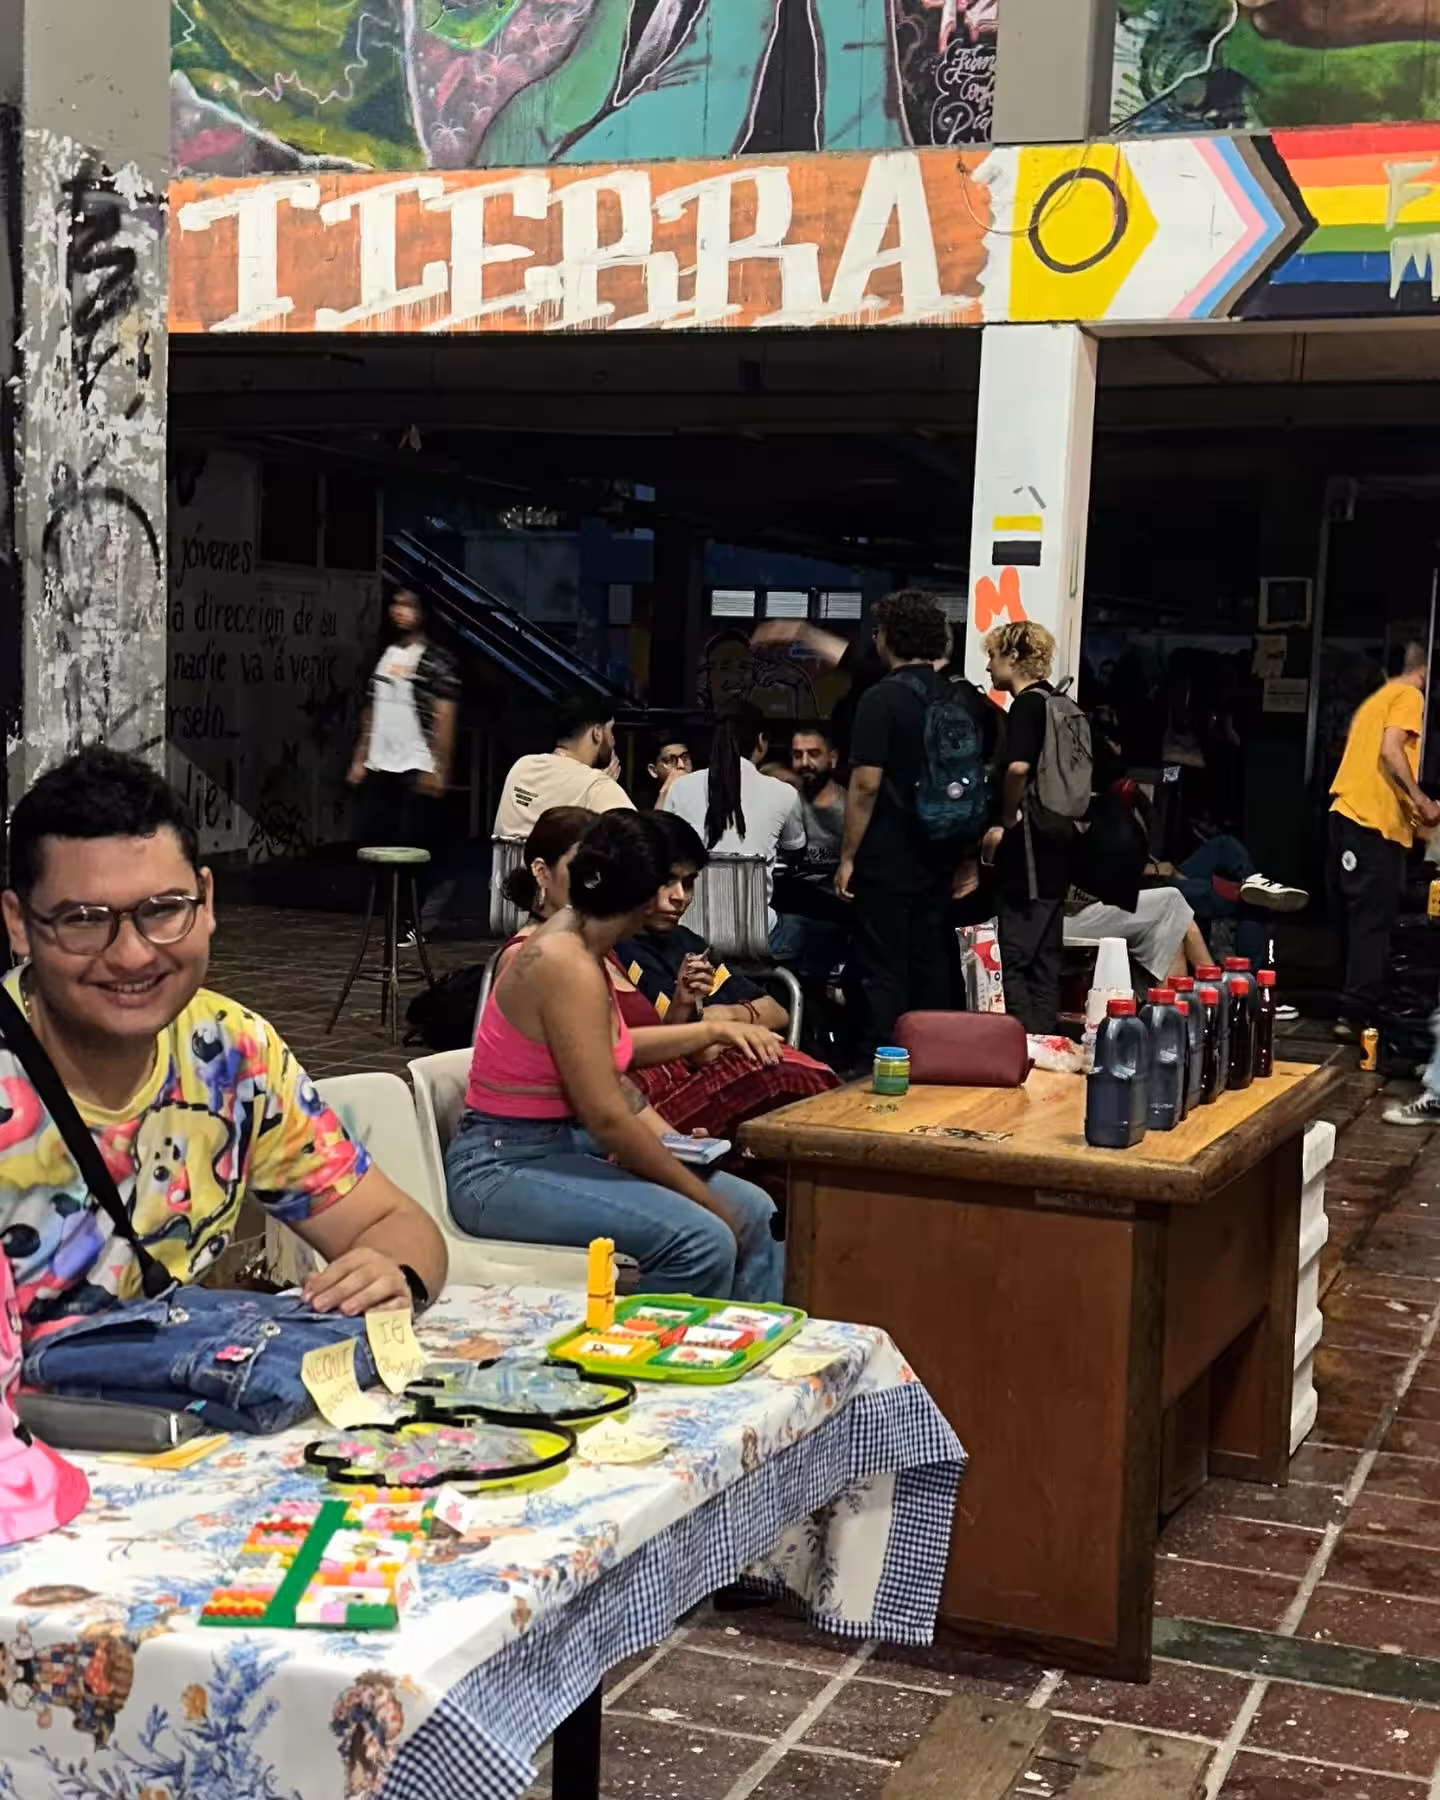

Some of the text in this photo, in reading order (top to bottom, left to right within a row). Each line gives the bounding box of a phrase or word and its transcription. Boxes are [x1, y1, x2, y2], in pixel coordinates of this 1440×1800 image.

[178, 152, 979, 331] TIERRA
[176, 522, 252, 588] jóvenes
[294, 592, 313, 635] de
[174, 639, 226, 681] nadie
[240, 652, 264, 683] va
